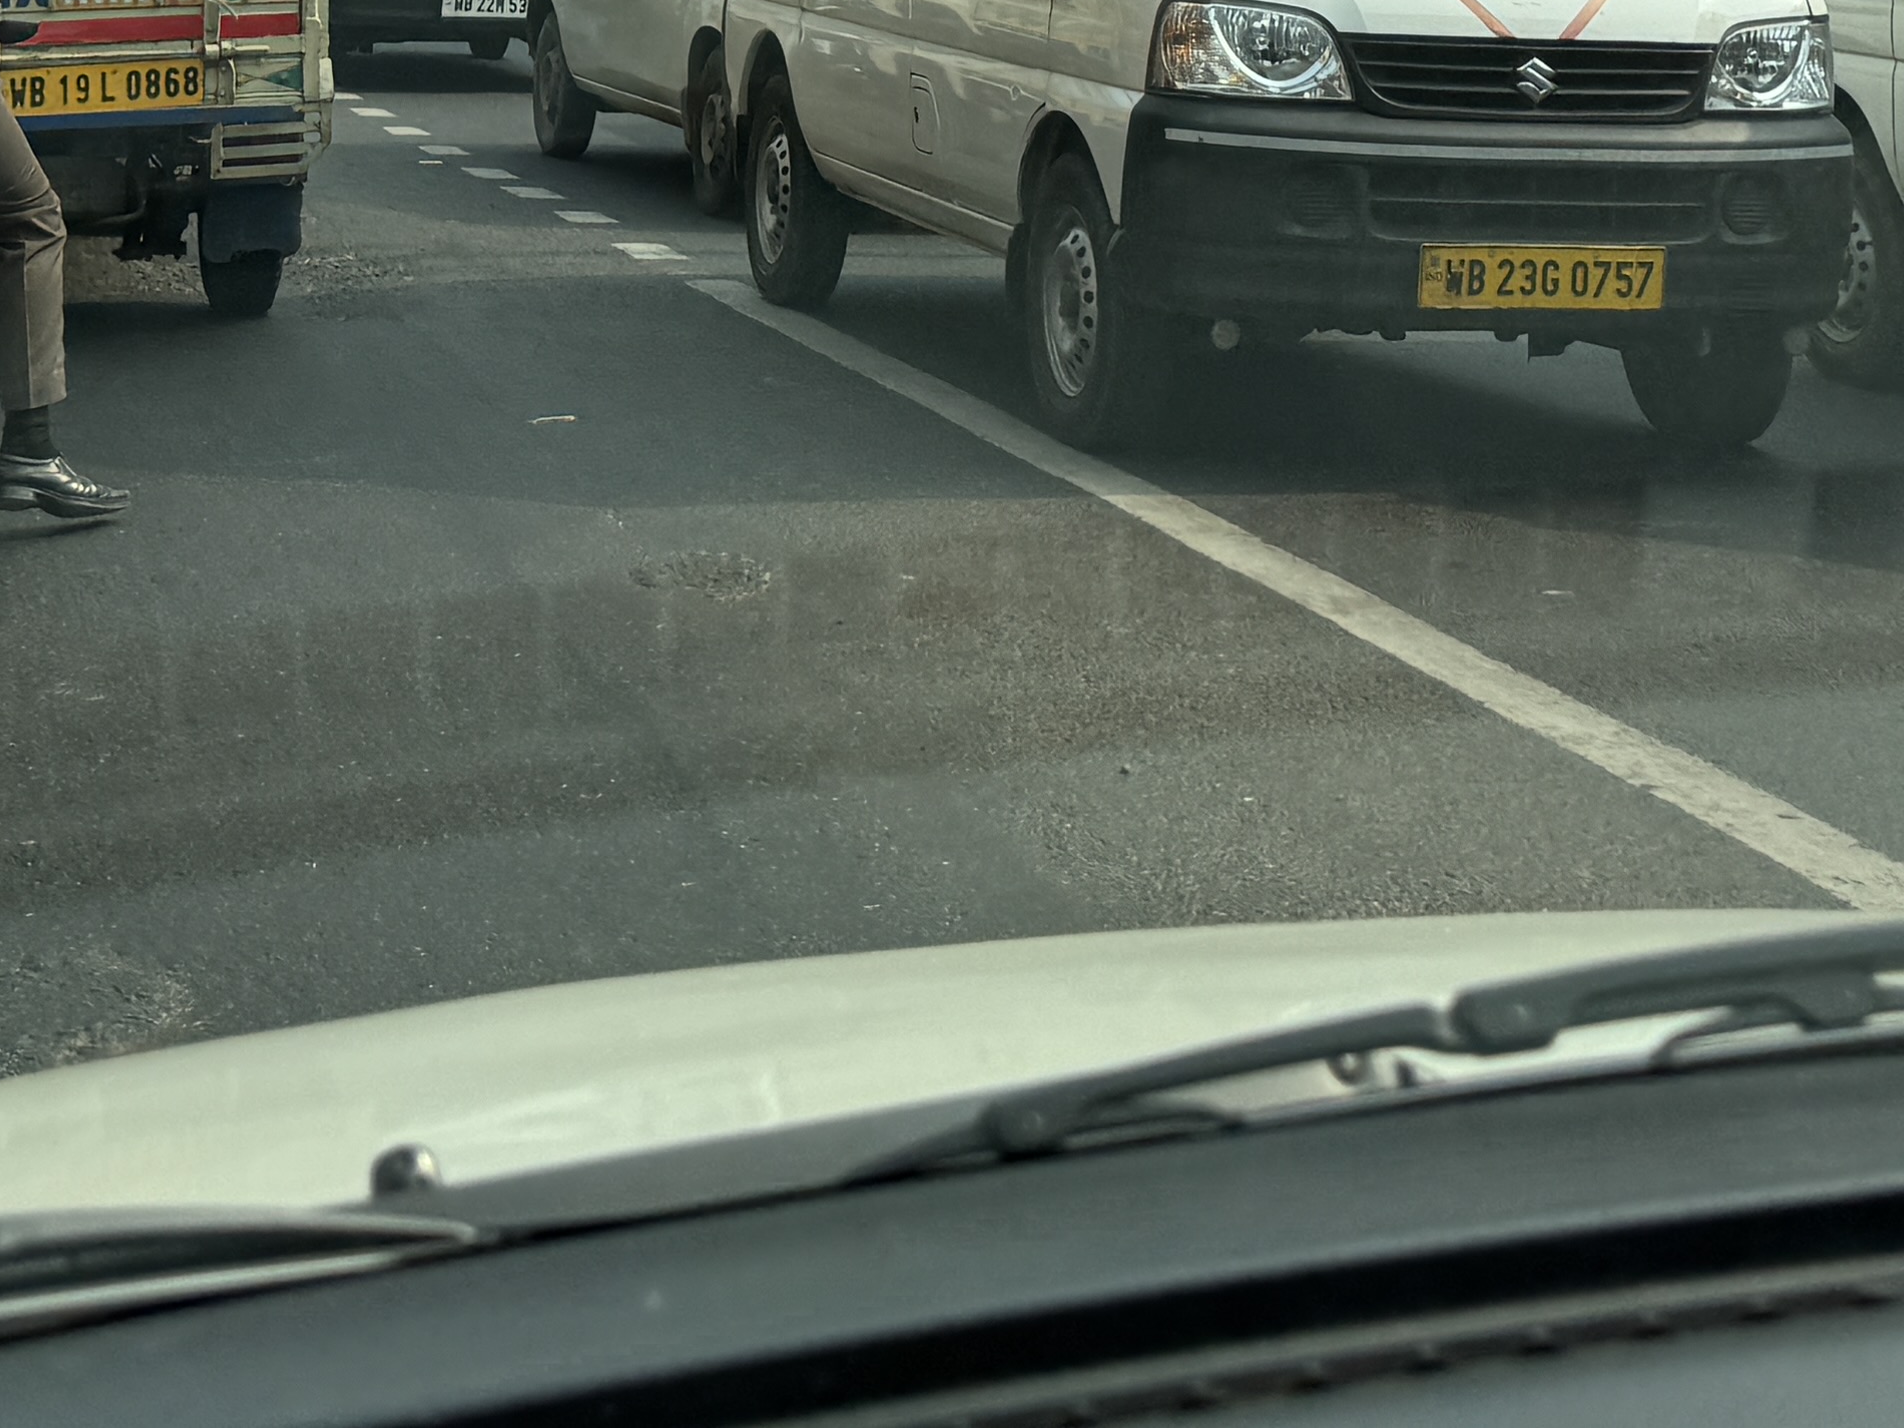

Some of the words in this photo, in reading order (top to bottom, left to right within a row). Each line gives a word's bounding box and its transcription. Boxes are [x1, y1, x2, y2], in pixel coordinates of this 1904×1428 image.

[9, 75, 46, 109] WB
[59, 73, 91, 106] 19
[100, 71, 116, 103] L
[126, 66, 200, 101] 0868
[1445, 258, 1487, 297] WB
[1496, 258, 1560, 297] 23G
[1570, 259, 1655, 299] 0757
